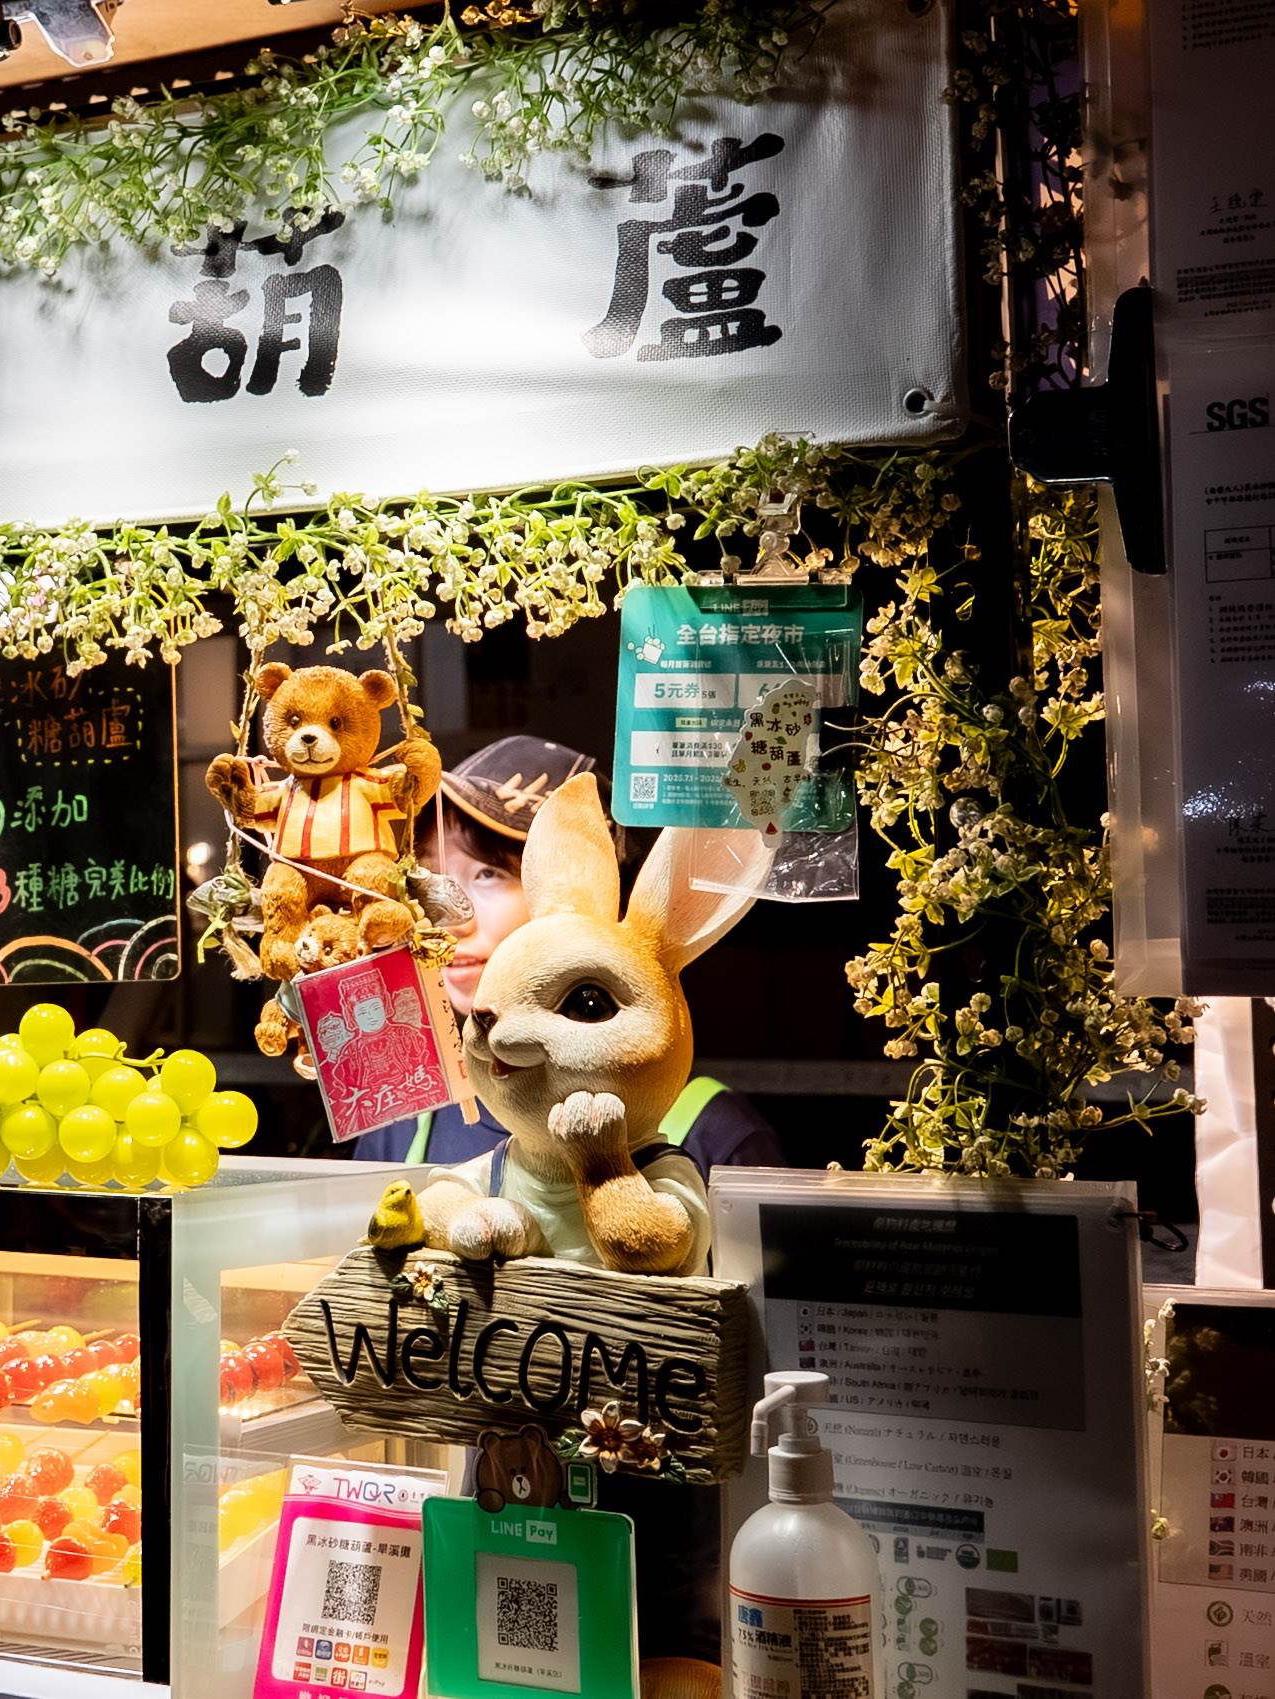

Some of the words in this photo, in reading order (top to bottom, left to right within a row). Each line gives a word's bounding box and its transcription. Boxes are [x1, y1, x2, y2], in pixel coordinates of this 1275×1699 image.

[1206, 397, 1270, 432] SGS
[677, 623, 805, 645] 全台指定夜市
[654, 683, 700, 699] 5元券
[27, 699, 133, 756] 糖葫蘆
[750, 712, 802, 736] 黑冰砂
[751, 740, 802, 766] 糖葫蘆
[841, 1309, 869, 1320] Japan
[844, 1361, 882, 1371] Australia
[845, 1377, 870, 1388] South
[1242, 1447, 1270, 1460] 日本
[333, 1477, 396, 1504] TWQR
[1241, 1495, 1268, 1510] 台灣
[491, 1521, 523, 1537] LINE
[530, 1524, 555, 1541] Pay
